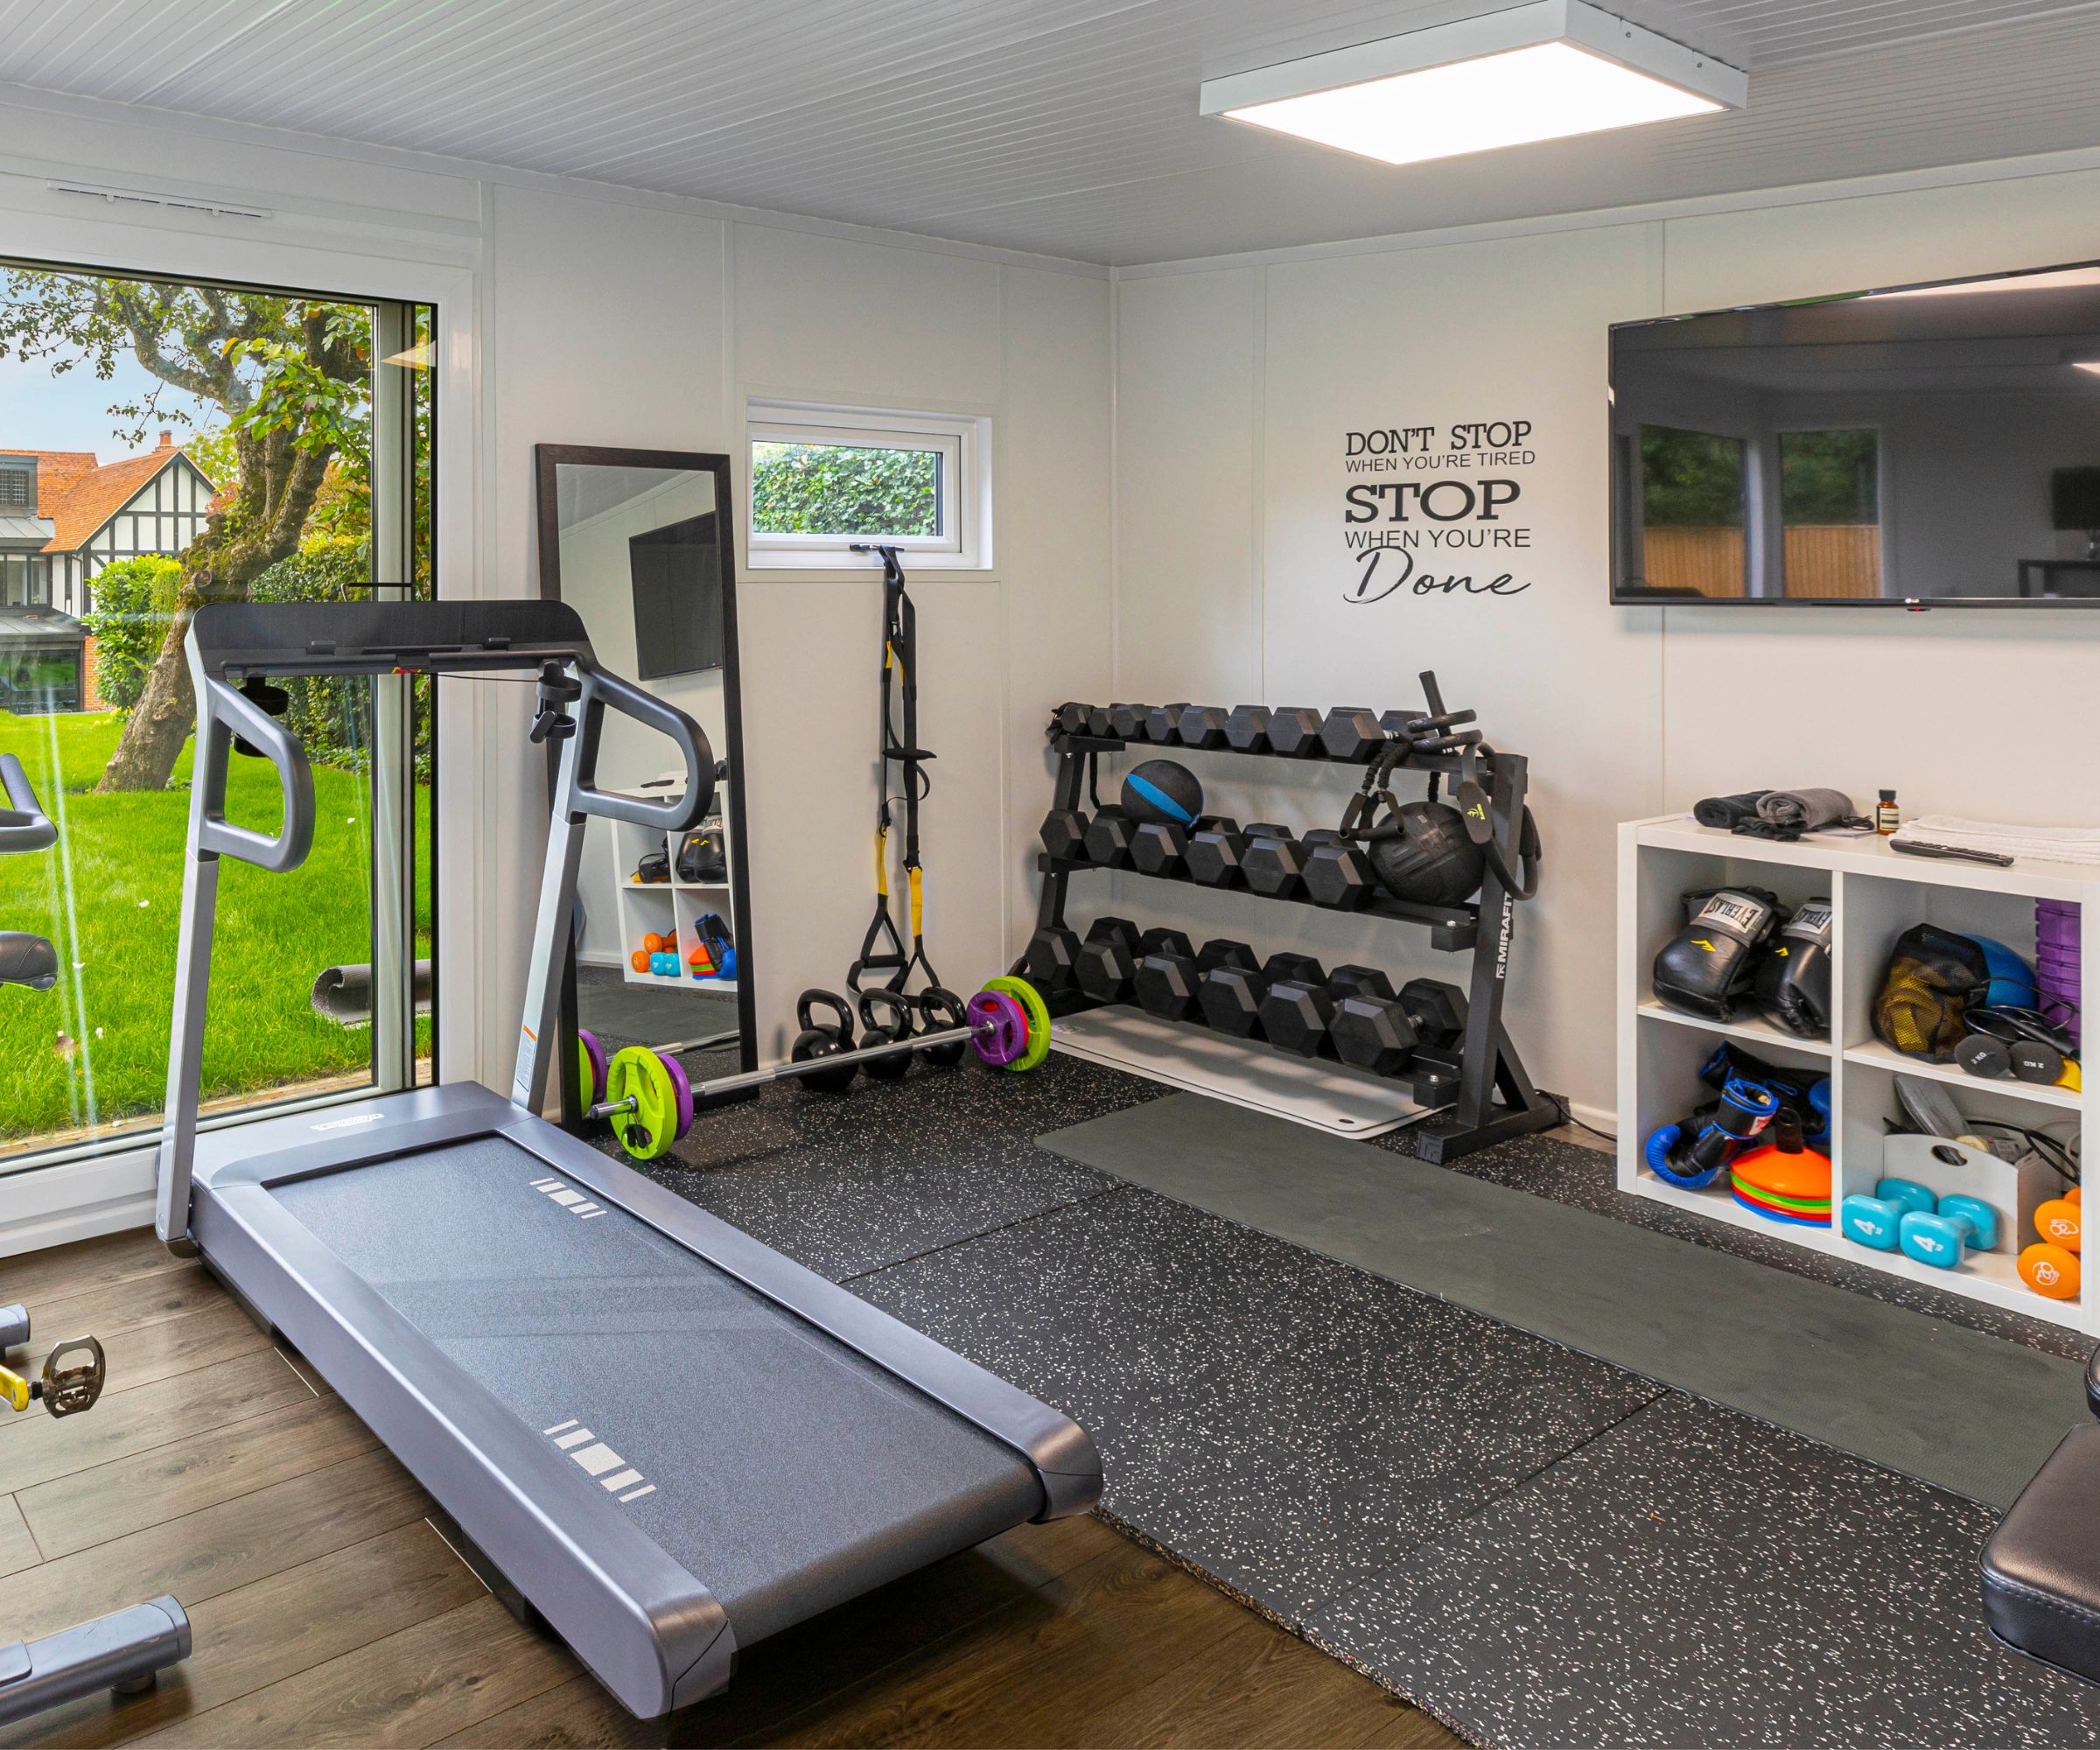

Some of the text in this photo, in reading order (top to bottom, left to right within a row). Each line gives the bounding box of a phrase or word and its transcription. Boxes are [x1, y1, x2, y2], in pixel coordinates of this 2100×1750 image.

[1345, 420, 1532, 456] DON'T STOP
[1345, 451, 1536, 472] WHEN YOU'RE TIRED
[1345, 480, 1521, 523] STOP
[1345, 528, 1531, 549] WHEN YOU'RE
[1343, 545, 1531, 604] Done
[1703, 898, 1760, 929] EVERLAST
[1853, 1218, 1875, 1236] 4
[1912, 1235, 1936, 1253] 4
